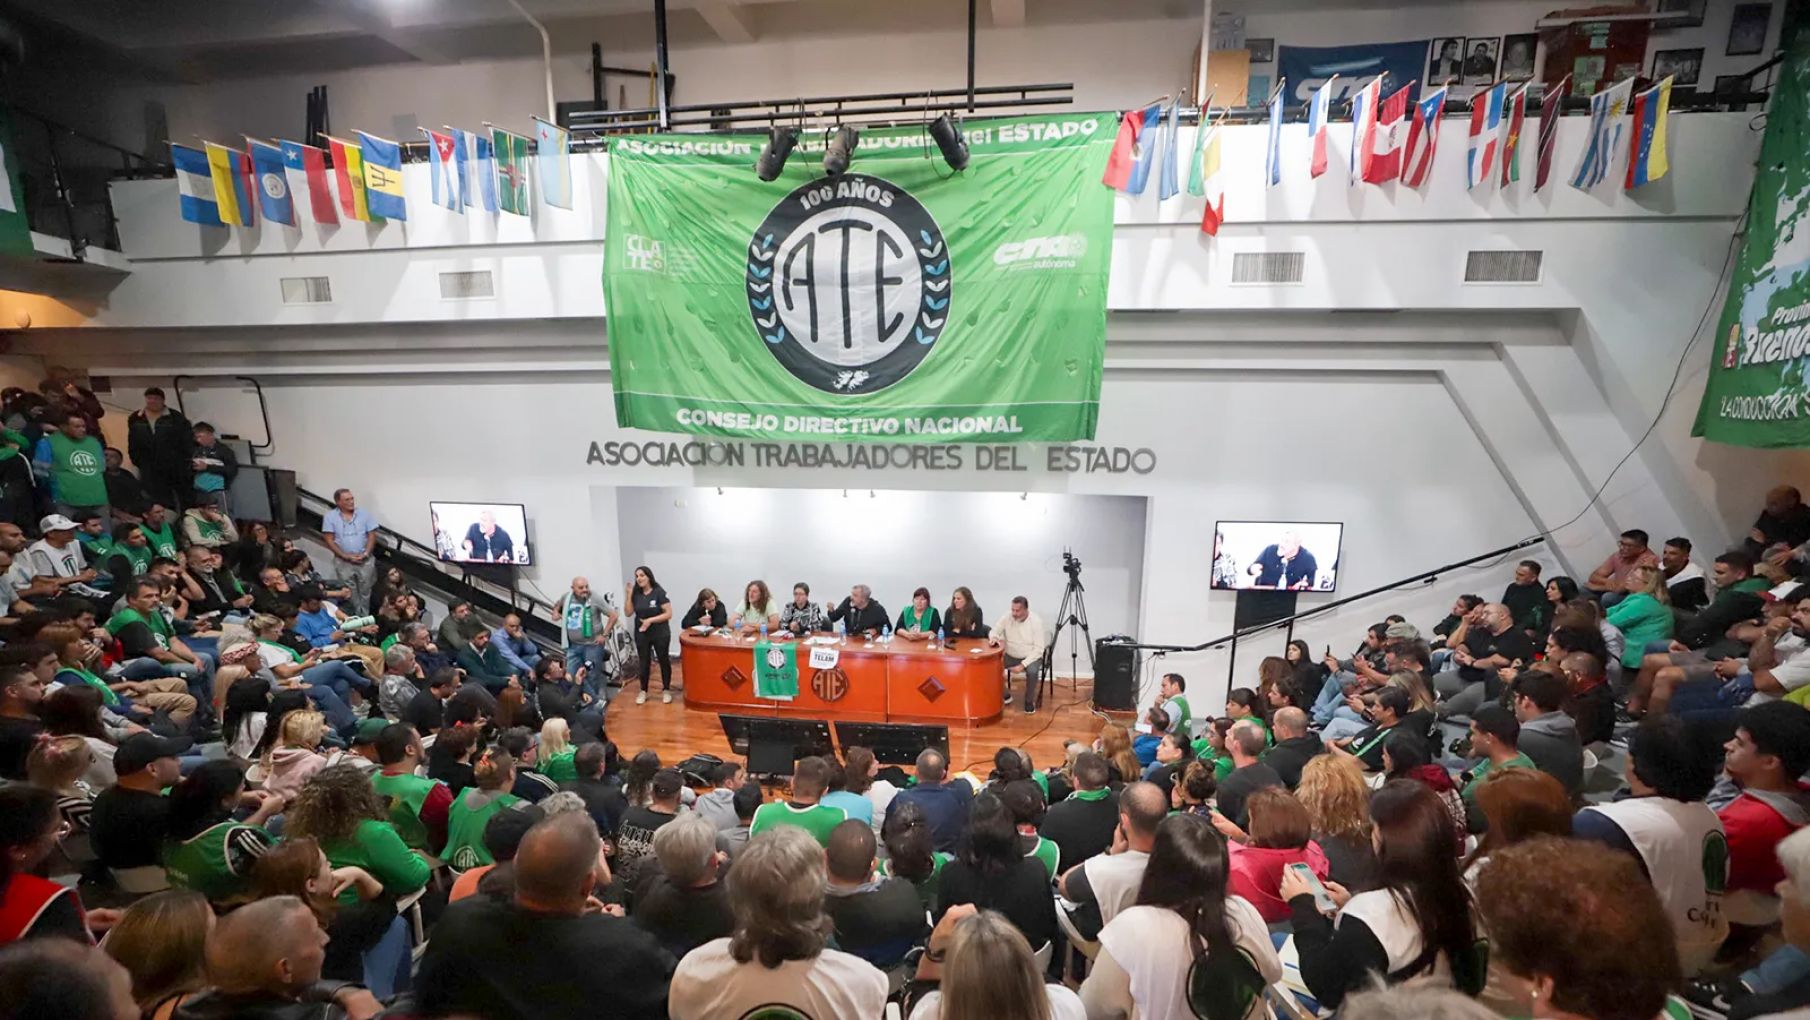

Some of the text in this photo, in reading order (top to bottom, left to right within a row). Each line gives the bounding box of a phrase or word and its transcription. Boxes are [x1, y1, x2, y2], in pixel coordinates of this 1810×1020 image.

[998, 118, 1099, 143] ESTADO
[800, 178, 895, 211] 100 AÑOS
[782, 219, 905, 349] ATE
[676, 407, 1023, 435] CONSEJO DIRECTIVO NACIONAL
[750, 442, 963, 471] TRABAJADORES
[975, 446, 1028, 472] DEL
[1046, 446, 1157, 474] ESTADO
[812, 669, 845, 700] ATE
